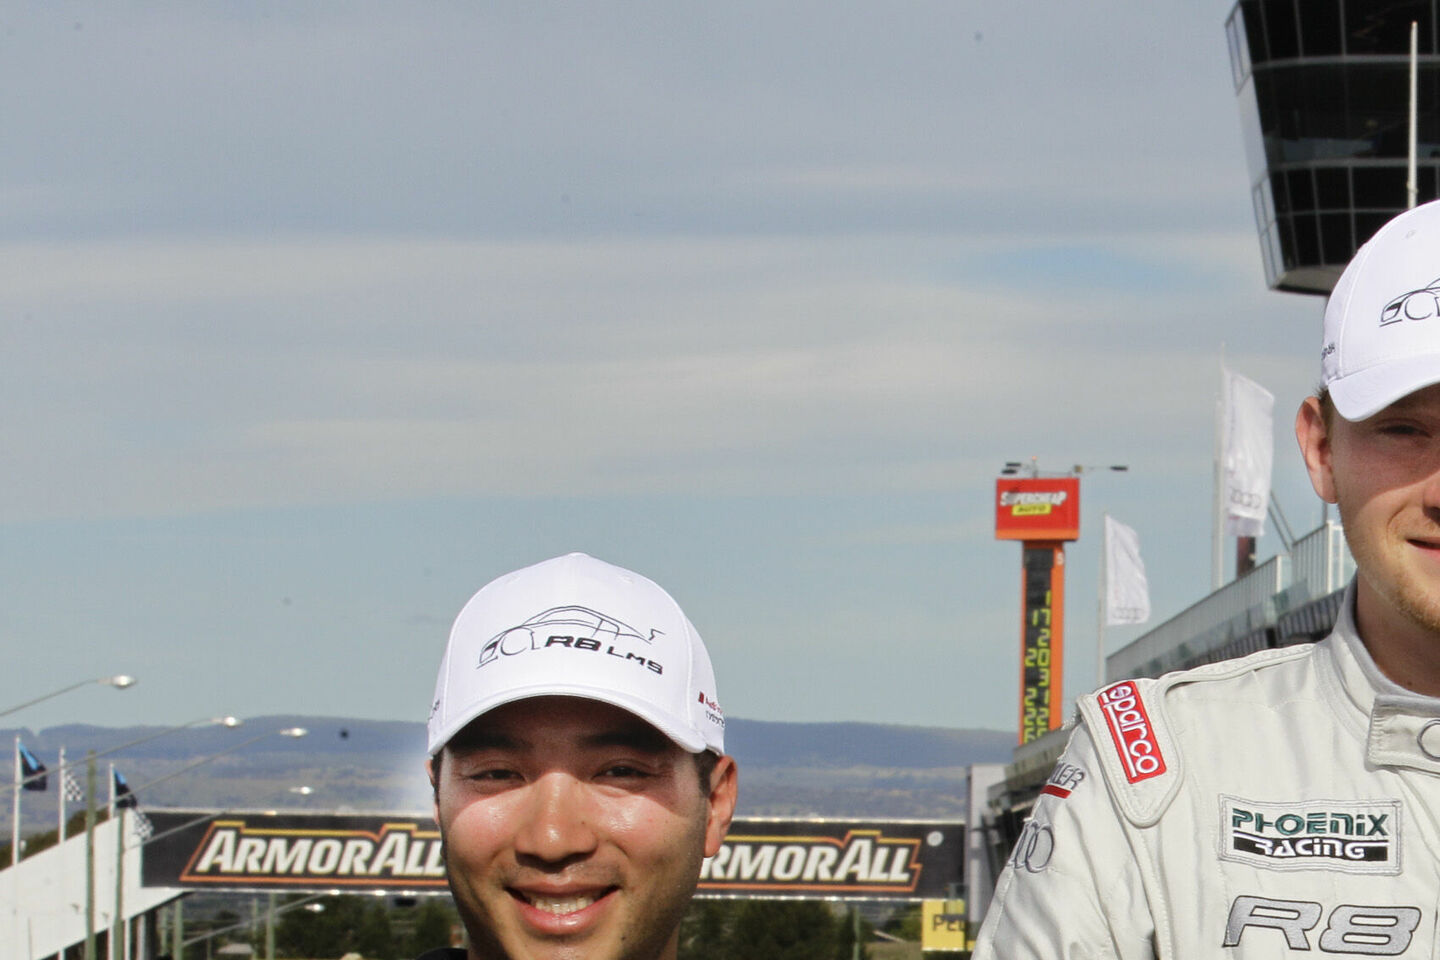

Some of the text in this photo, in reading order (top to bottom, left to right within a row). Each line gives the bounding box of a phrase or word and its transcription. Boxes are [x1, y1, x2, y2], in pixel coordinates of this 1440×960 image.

[545, 635, 663, 676] R8 LMS
[1024, 647, 1051, 667] 20
[1038, 668, 1050, 687] 3
[1221, 895, 1422, 956] R8
